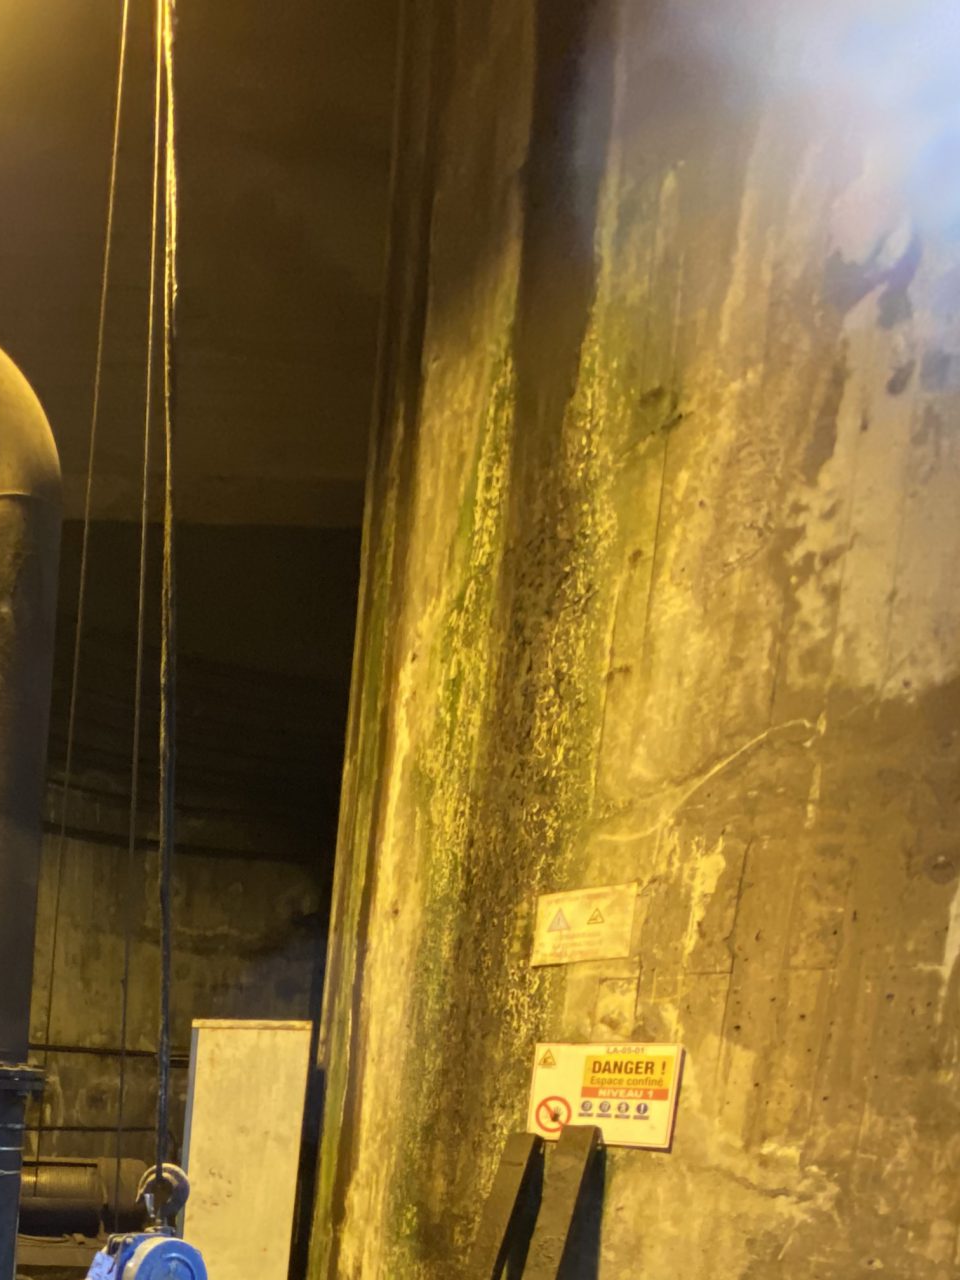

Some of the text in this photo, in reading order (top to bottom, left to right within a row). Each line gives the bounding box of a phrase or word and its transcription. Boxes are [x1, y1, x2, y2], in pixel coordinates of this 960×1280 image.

[592, 1061, 655, 1075] DANGER
[591, 1076, 624, 1087] Espace
[598, 1089, 643, 1098] NIVEAU
